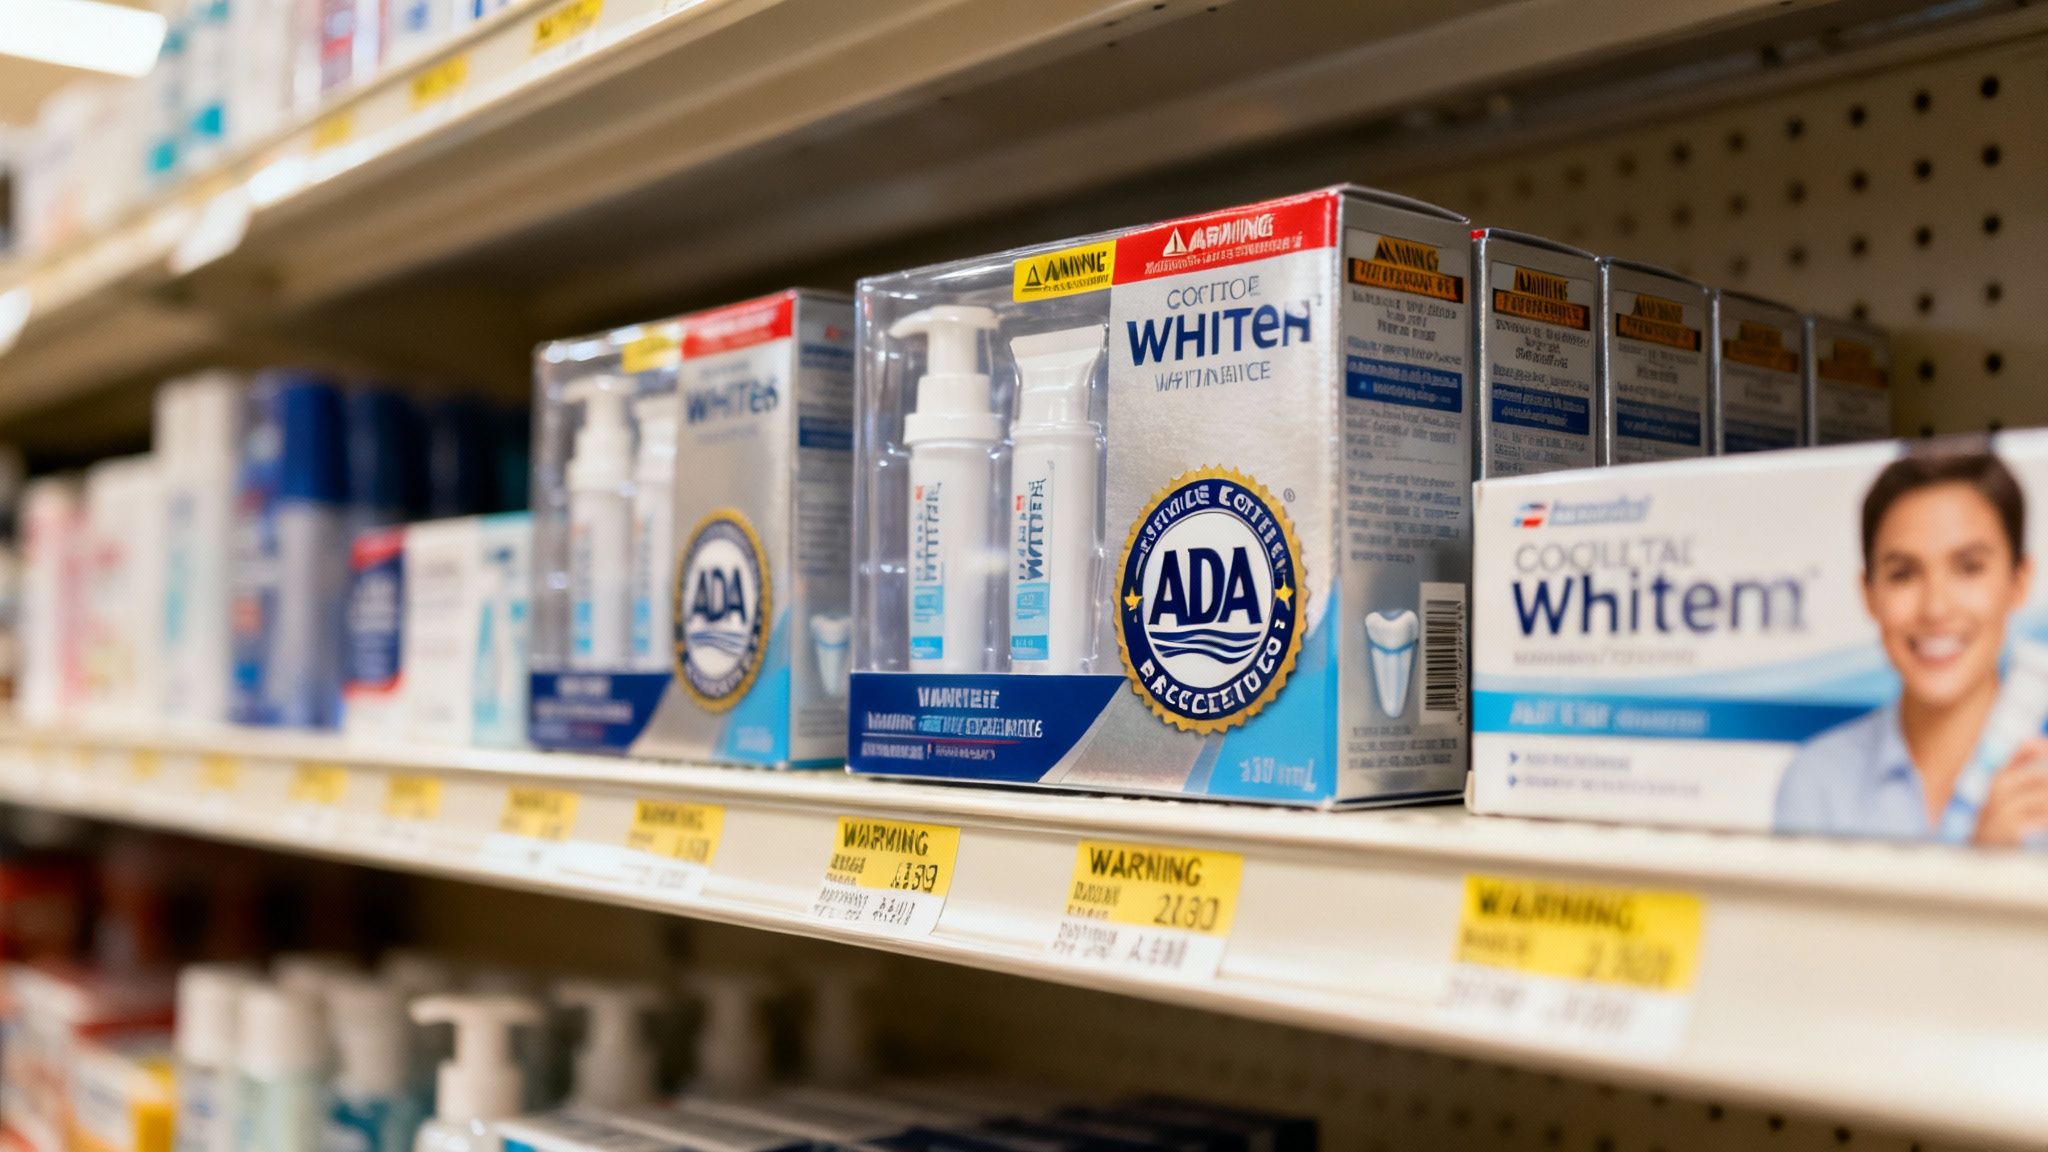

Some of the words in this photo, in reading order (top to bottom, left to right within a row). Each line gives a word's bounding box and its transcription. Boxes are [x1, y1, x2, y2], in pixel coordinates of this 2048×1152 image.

[692, 567, 748, 627] ADA
[1148, 547, 1264, 627] ADA
[844, 822, 929, 857] WARNING
[1090, 847, 1203, 888] WARNING
